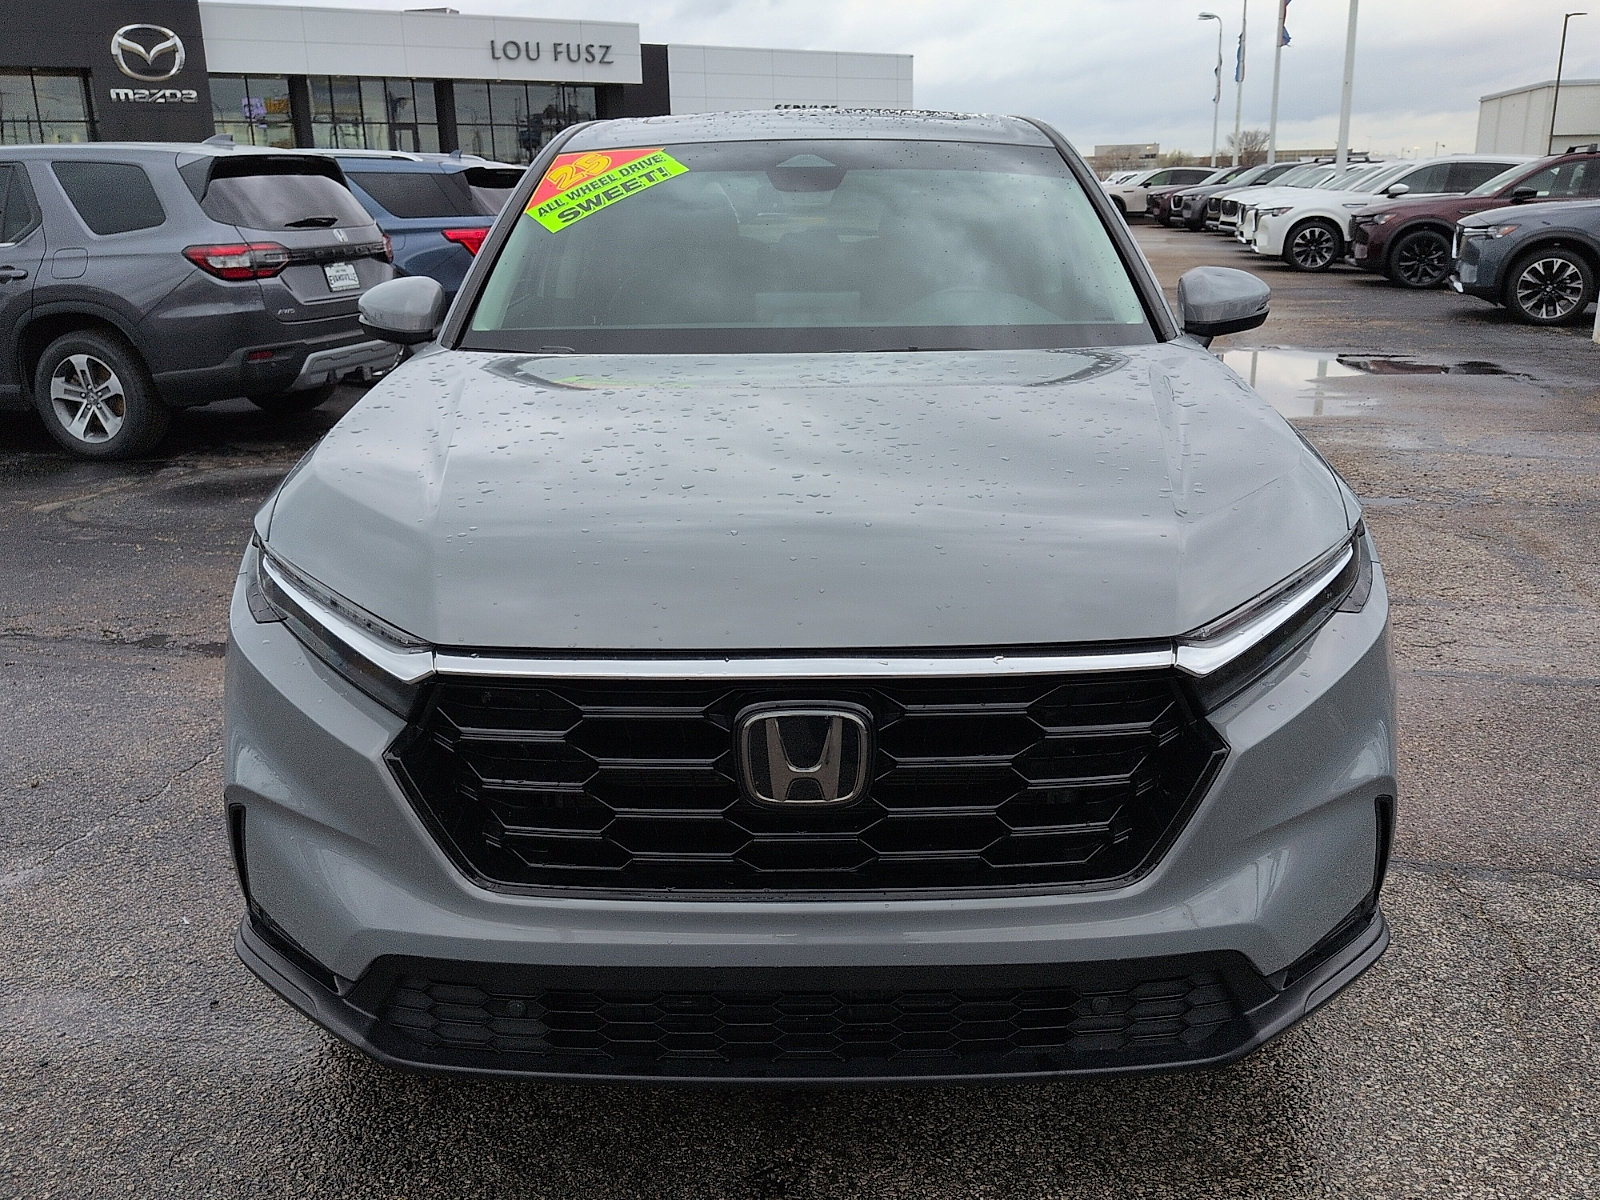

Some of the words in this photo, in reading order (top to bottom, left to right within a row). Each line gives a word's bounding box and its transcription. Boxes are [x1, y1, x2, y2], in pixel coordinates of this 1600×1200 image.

[490, 40, 540, 61] LOU
[552, 42, 614, 64] FUSZ
[546, 152, 612, 191] 25
[538, 198, 566, 217] ALL
[566, 174, 617, 201] WHEEL
[557, 166, 670, 224] SWEET!
